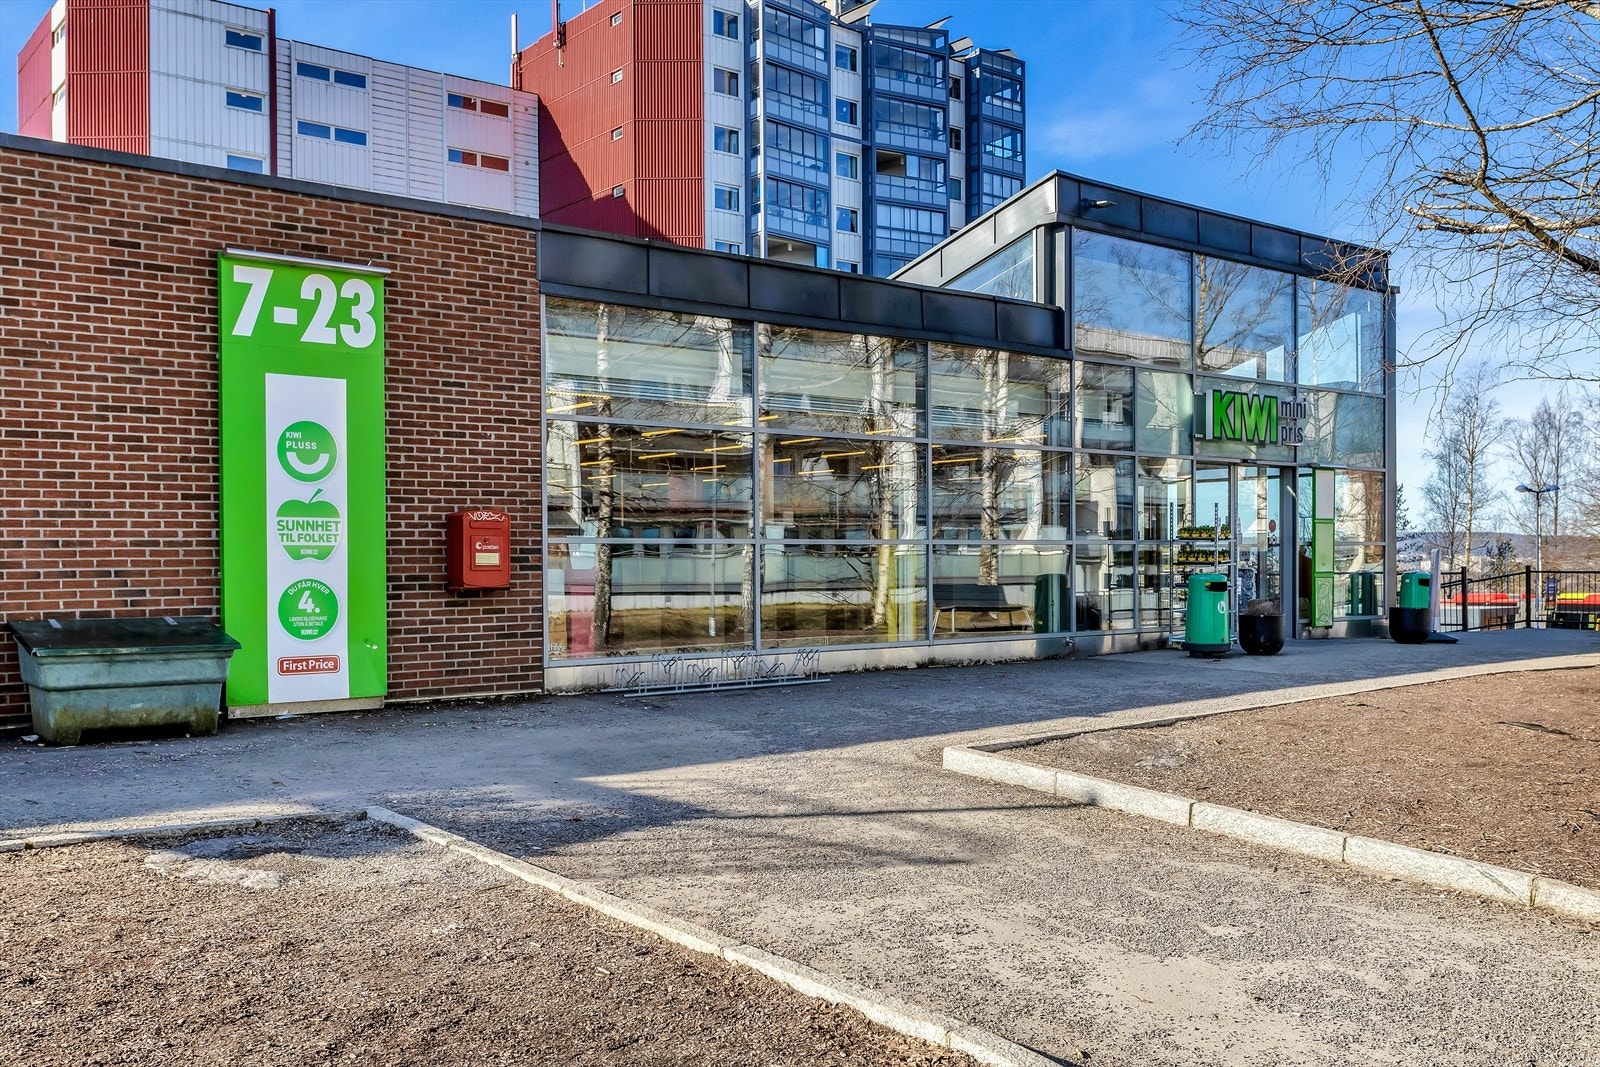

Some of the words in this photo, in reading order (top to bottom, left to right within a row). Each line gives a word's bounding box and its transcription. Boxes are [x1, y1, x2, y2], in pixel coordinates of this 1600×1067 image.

[232, 265, 377, 349] 7-23
[1280, 398, 1307, 419] mini
[1212, 389, 1278, 445] KIWI
[286, 431, 302, 439] KIWI
[1281, 422, 1304, 446] pris
[286, 440, 317, 450] PLUSS
[277, 520, 341, 532] SUNNHET
[279, 533, 295, 543] TIL
[297, 533, 339, 543] FOLKET
[288, 585, 298, 595] DU
[298, 581, 311, 589] FÅR
[312, 582, 330, 595] HVER
[298, 590, 320, 613] 4.
[283, 660, 307, 671] First
[308, 659, 335, 670] Price
